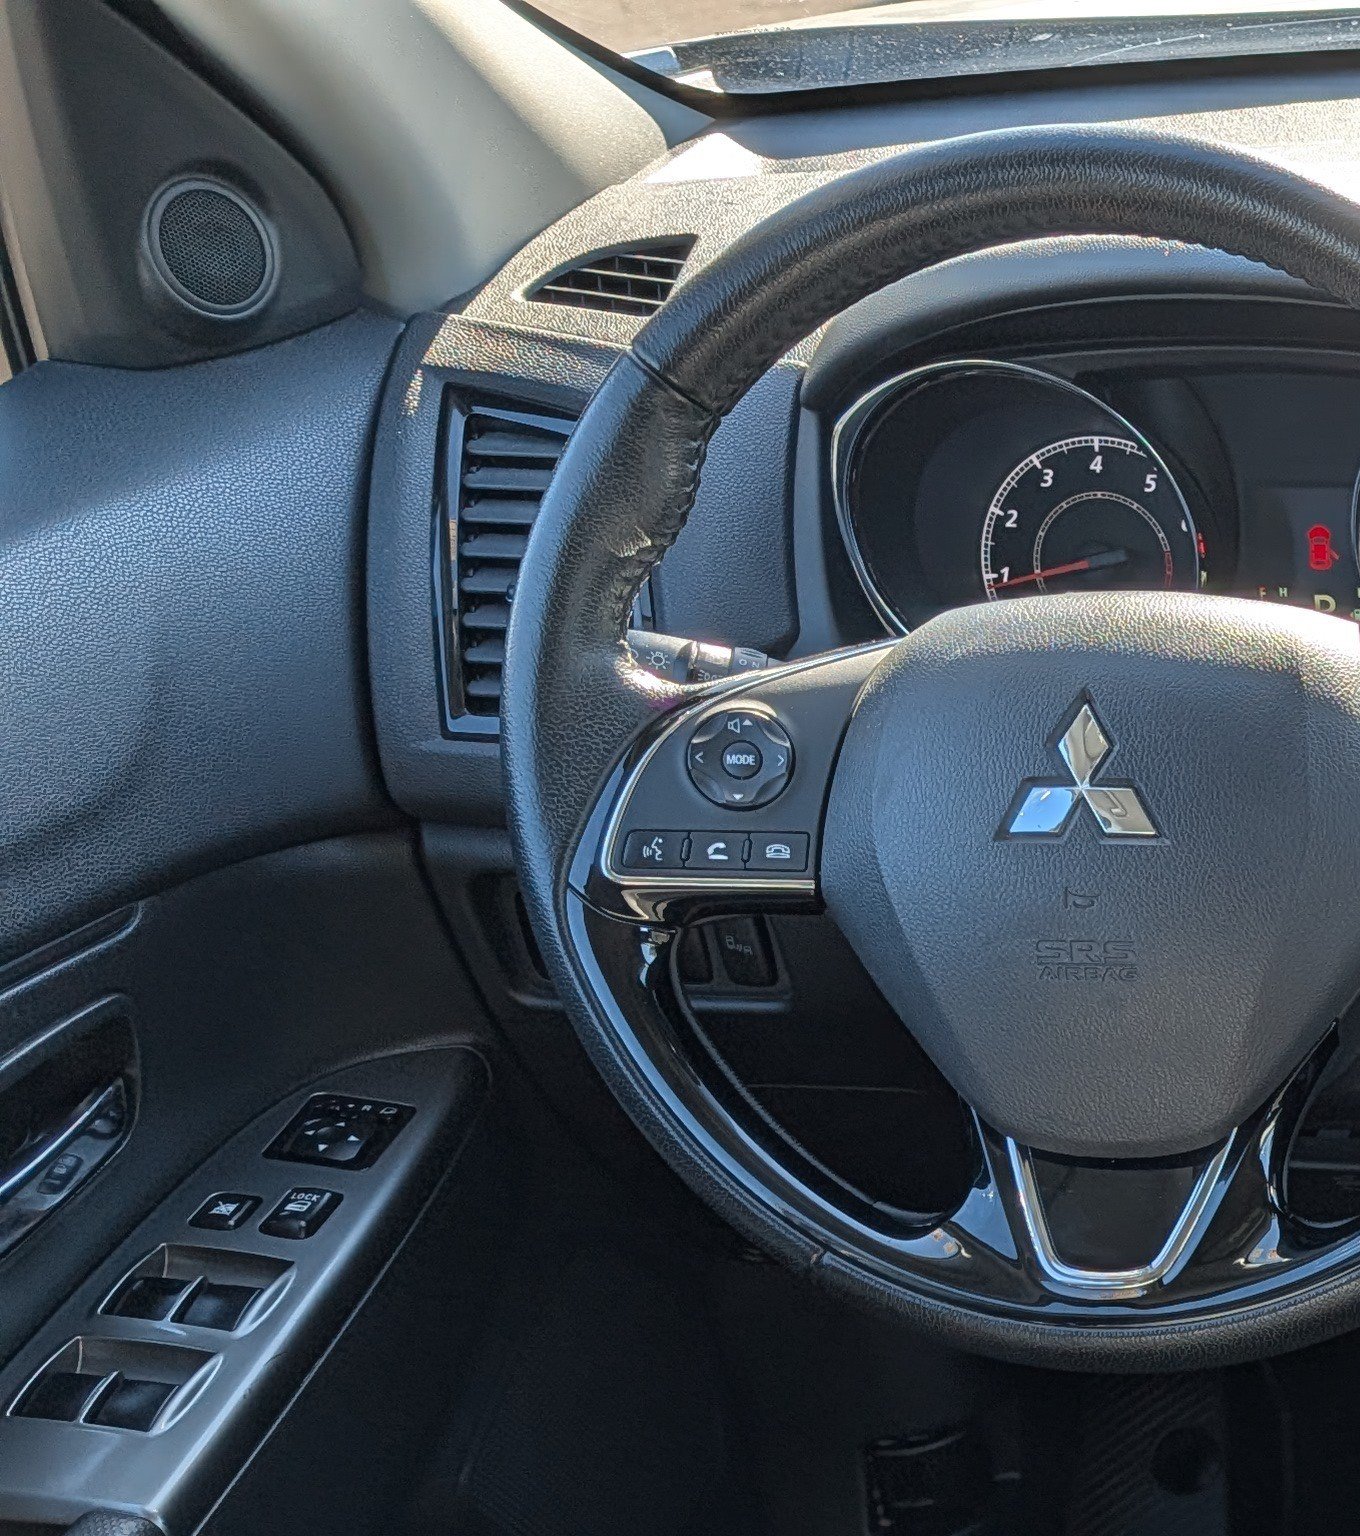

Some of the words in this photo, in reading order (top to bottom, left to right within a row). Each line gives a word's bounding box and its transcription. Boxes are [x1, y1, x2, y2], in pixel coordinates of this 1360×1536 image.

[1089, 456, 1103, 473] 4
[1040, 469, 1054, 487] 3
[1144, 475, 1157, 492] 5
[1005, 510, 1018, 528] 2
[1000, 566, 1010, 583] 1
[1314, 594, 1336, 612] D
[726, 754, 756, 766] MODE
[1036, 939, 1136, 965] SRS
[1037, 966, 1138, 982] AIRBAG
[290, 1192, 321, 1203] LOCK
